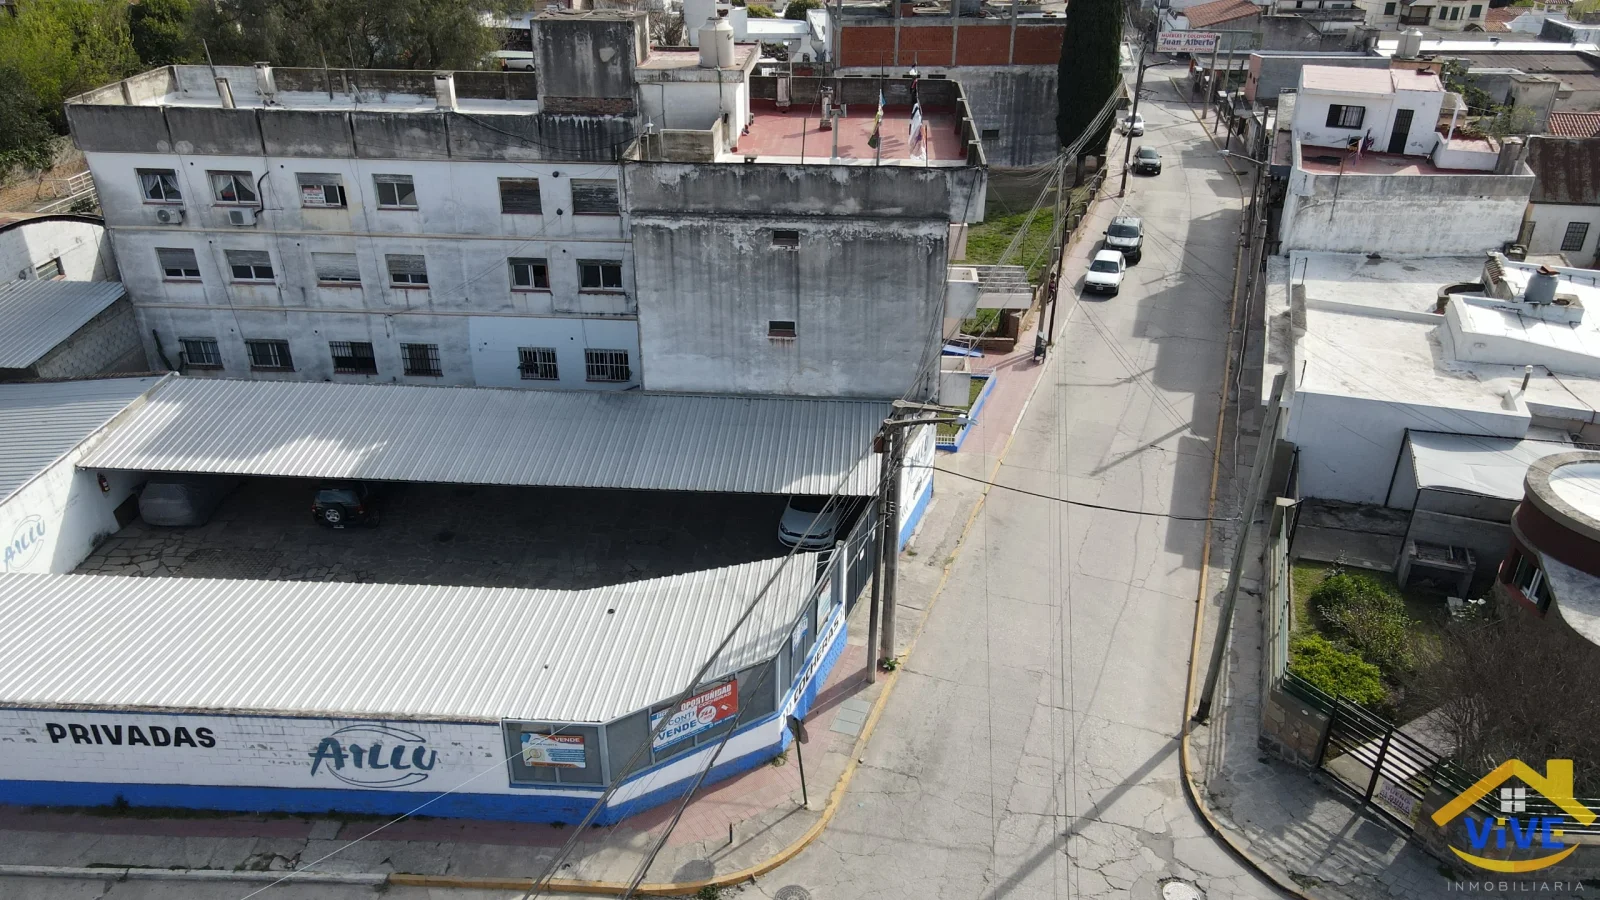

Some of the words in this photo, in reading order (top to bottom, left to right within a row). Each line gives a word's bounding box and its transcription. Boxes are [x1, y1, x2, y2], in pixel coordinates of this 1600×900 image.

[794, 618, 840, 703] COCHERAS
[681, 684, 731, 711] OPORTUNIDAD
[46, 722, 216, 748] PRIVADAS
[658, 720, 698, 740] VENDE
